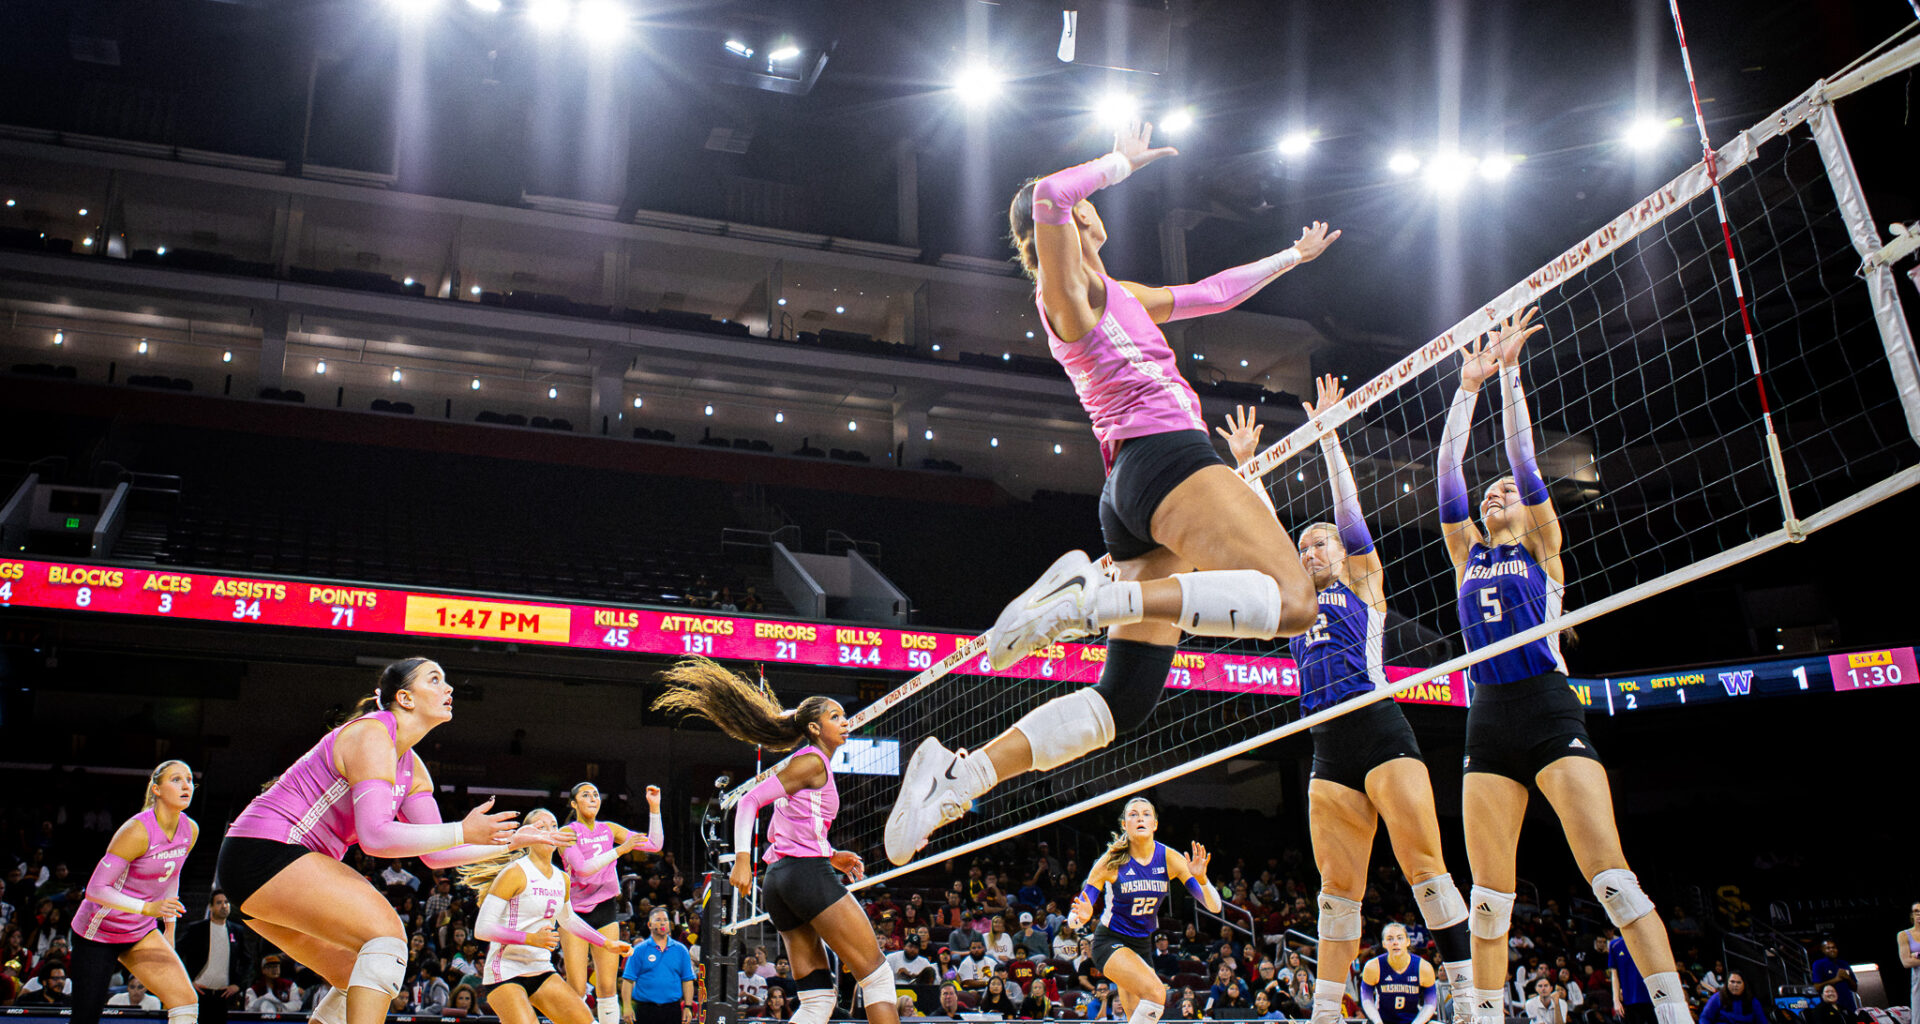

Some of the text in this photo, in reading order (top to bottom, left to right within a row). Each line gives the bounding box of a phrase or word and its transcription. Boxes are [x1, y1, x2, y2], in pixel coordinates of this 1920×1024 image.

[1527, 188, 1676, 290] WOMEN OF TROY
[1346, 333, 1455, 411] WOMEN OF TROY
[1266, 437, 1292, 462] TROY
[49, 565, 124, 588] BLOCKS
[143, 574, 192, 593] ACES
[75, 586, 92, 607] 8
[212, 580, 287, 600] ASSISTS
[309, 587, 377, 608] POINTS
[158, 593, 172, 613] 3
[232, 600, 261, 620] 34
[1480, 586, 1502, 623] 5
[331, 608, 354, 627] 71
[436, 607, 540, 633] 1:47 PM
[594, 610, 639, 628] KILLS
[660, 615, 734, 635] ATTACKS
[604, 629, 629, 647] 45
[755, 622, 817, 641] ERRORS
[836, 629, 883, 646] KILL%
[682, 634, 713, 654] 131
[776, 641, 797, 659] 21
[901, 633, 937, 650] DIGS
[838, 645, 881, 666] 34.4
[908, 650, 931, 668] 50
[979, 656, 991, 672] 6
[1877, 653, 1885, 662] 4
[1041, 660, 1053, 677] 6
[1170, 669, 1191, 686] 73
[1224, 664, 1278, 686] TEAM
[1792, 665, 1809, 690] 1
[1847, 664, 1902, 688] 1:30
[1618, 681, 1640, 692] TOL
[1650, 673, 1705, 689] SETS WON
[1719, 670, 1753, 696] W
[1626, 694, 1638, 709] 2
[1676, 688, 1686, 704] 1
[592, 843, 603, 858] 2
[158, 861, 176, 883] 3
[1120, 879, 1168, 894] WASHINGTON
[544, 899, 557, 919] 6
[1131, 896, 1158, 916] 22
[1015, 968, 1033, 978] USC
[1381, 984, 1420, 994] WASHINGTON
[1395, 996, 1406, 1010] 8
